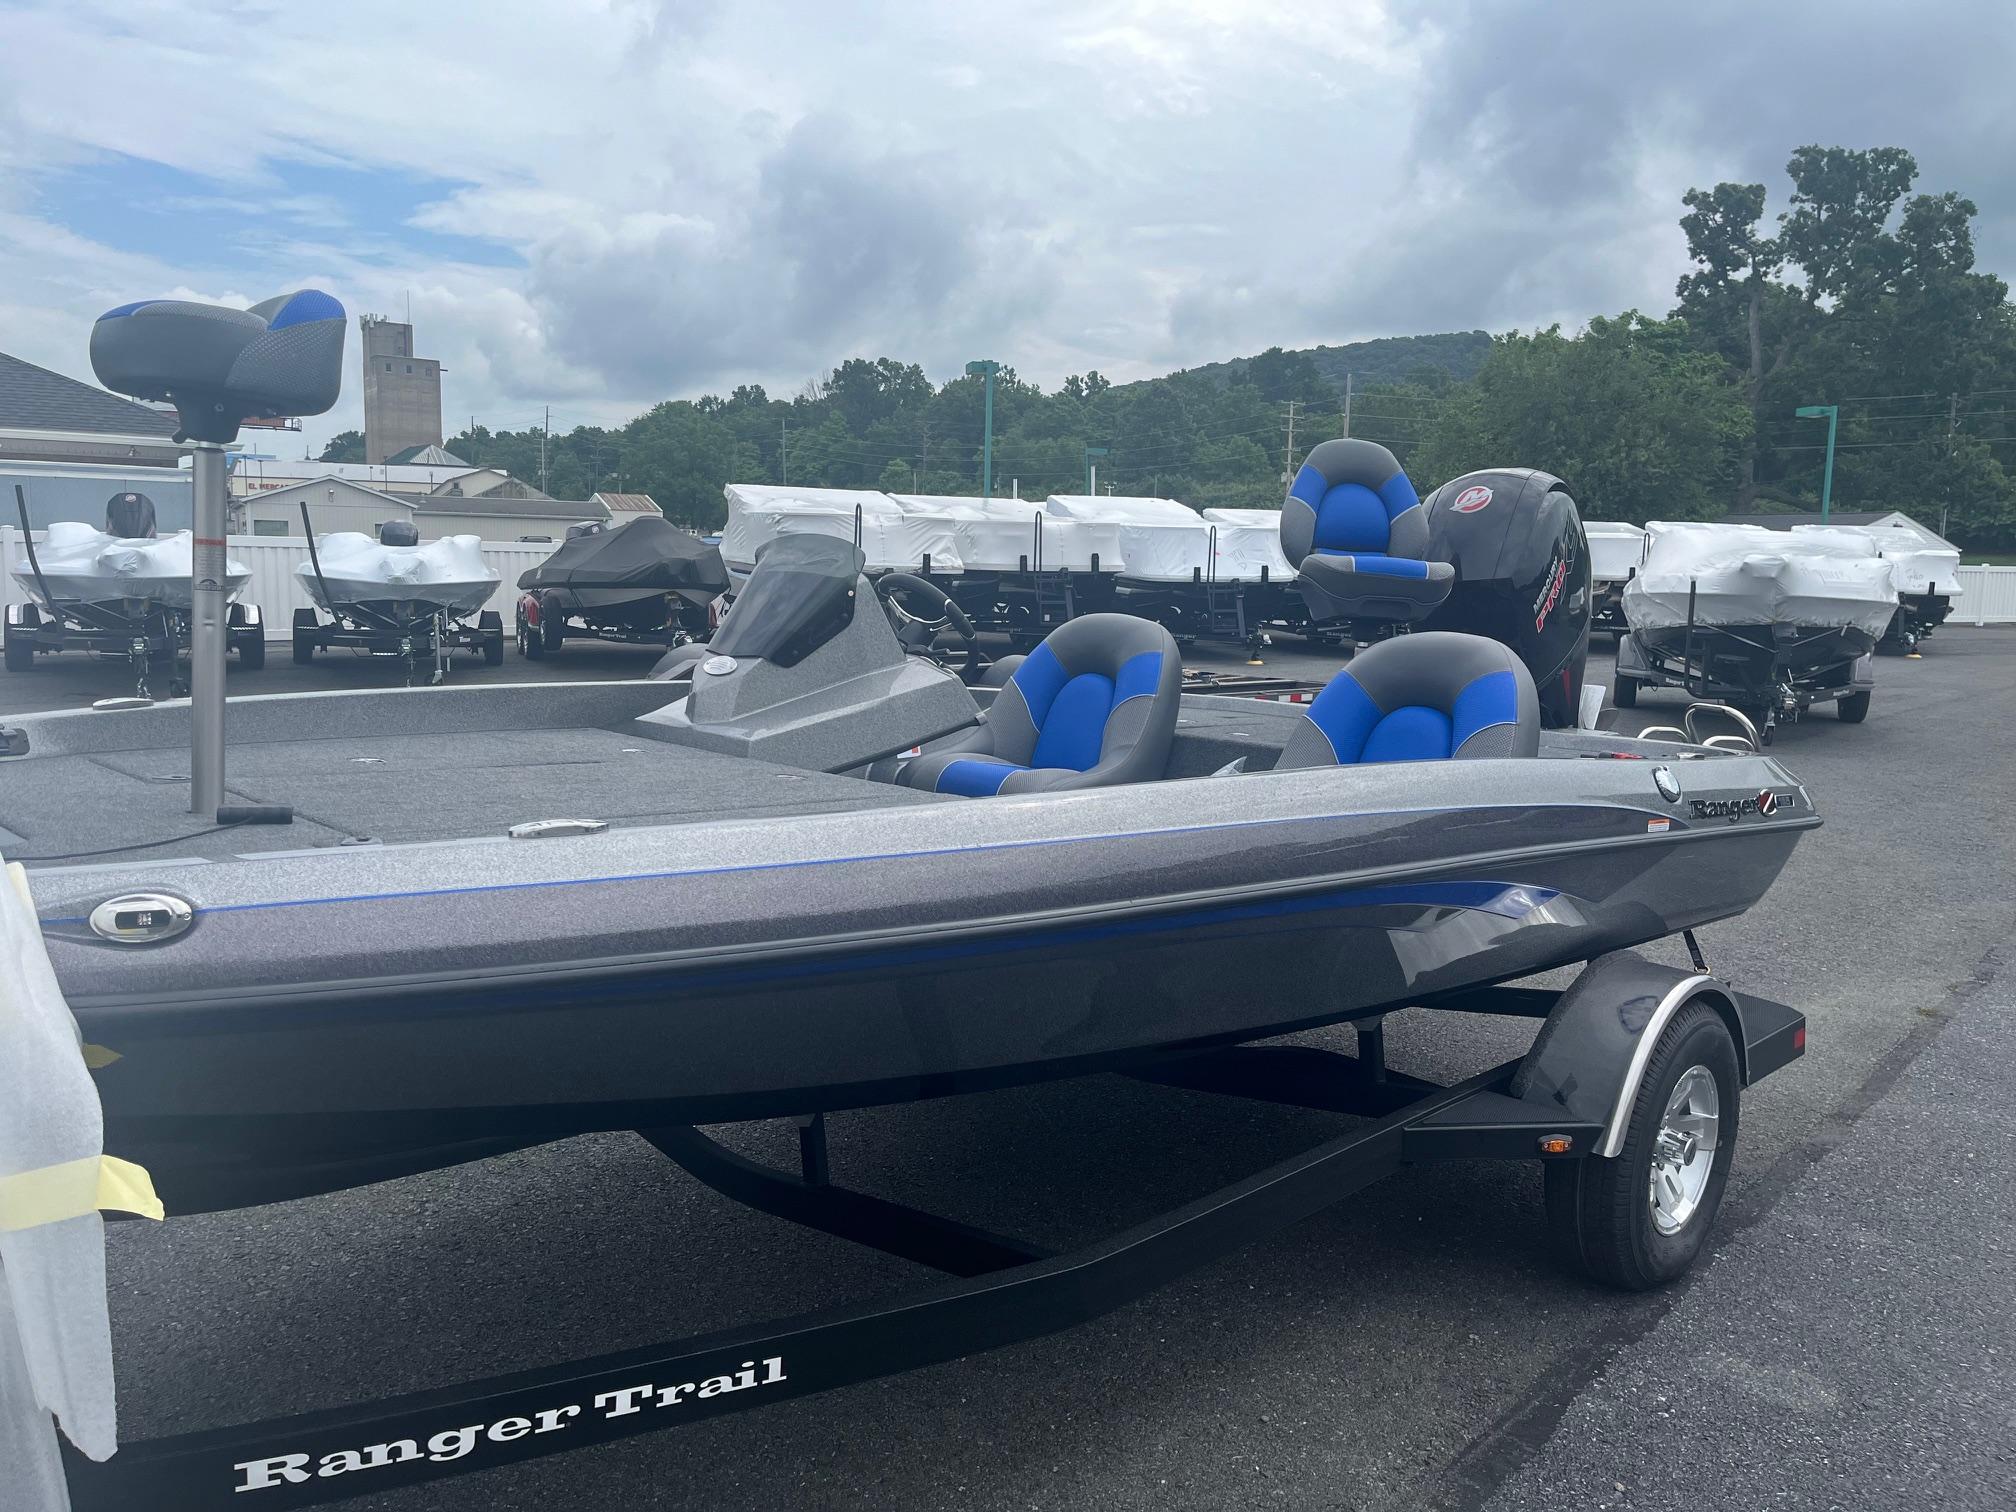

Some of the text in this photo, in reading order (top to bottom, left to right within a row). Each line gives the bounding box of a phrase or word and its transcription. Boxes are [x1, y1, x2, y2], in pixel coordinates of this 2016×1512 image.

[1533, 555, 1558, 614] MERCURY
[1688, 797, 1760, 823] Ranger
[234, 1356, 788, 1493] Ranger Trail
